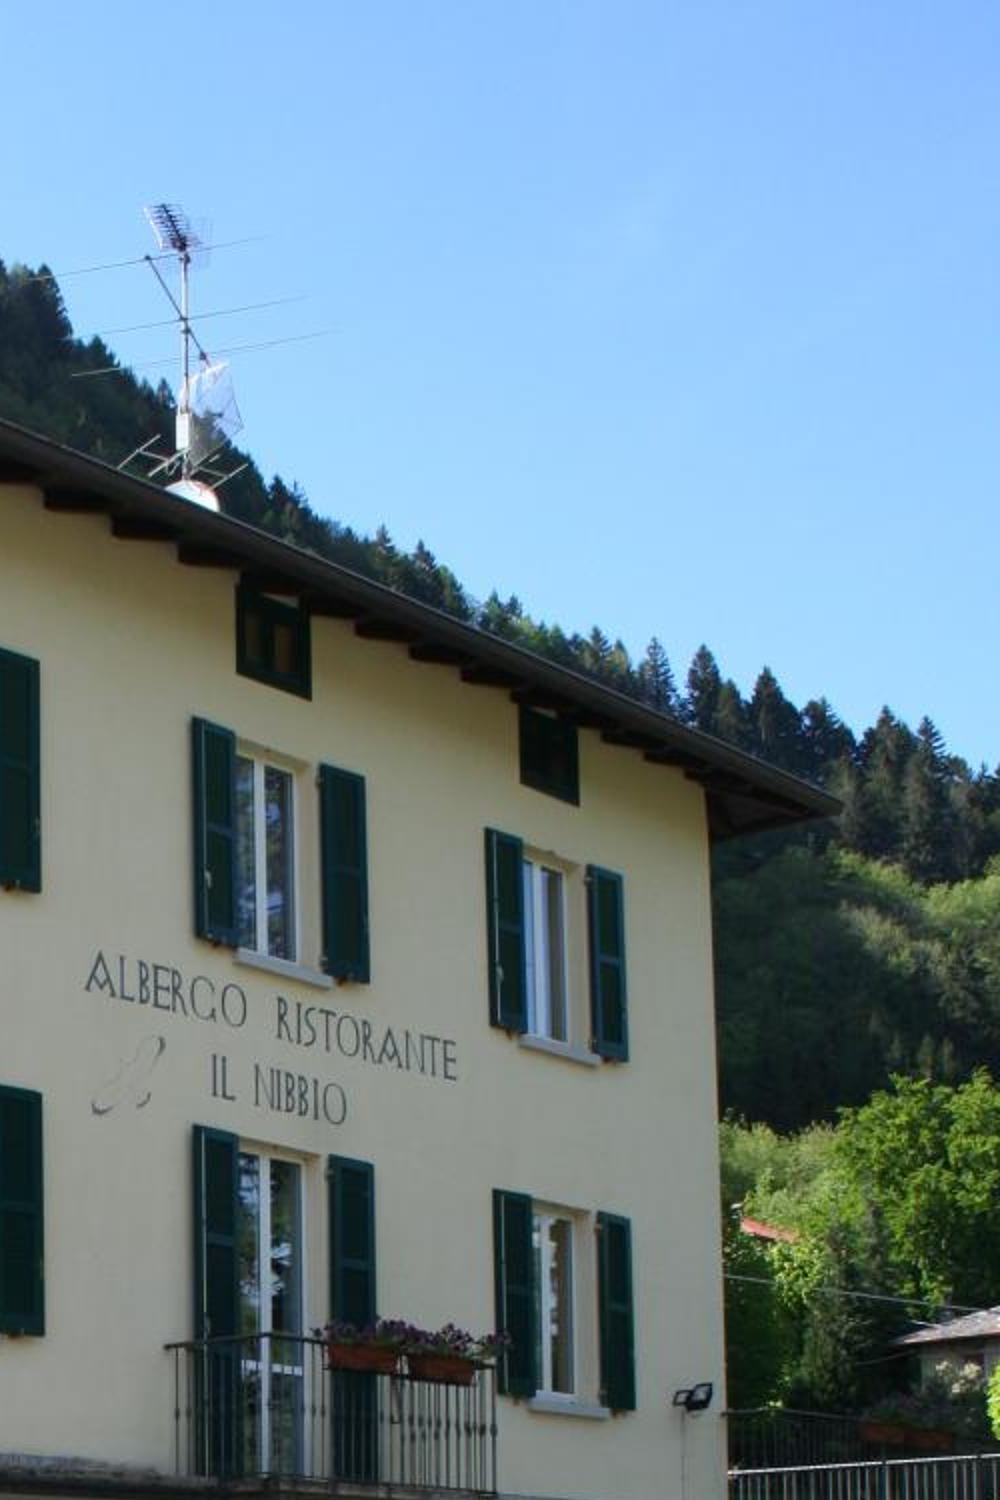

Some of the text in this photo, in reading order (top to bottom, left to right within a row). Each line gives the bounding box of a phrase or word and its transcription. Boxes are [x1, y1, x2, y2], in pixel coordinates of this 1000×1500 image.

[85, 949, 458, 1082] ALBERGO RISTORANTE
[211, 1053, 347, 1126] IL NIBBIO
